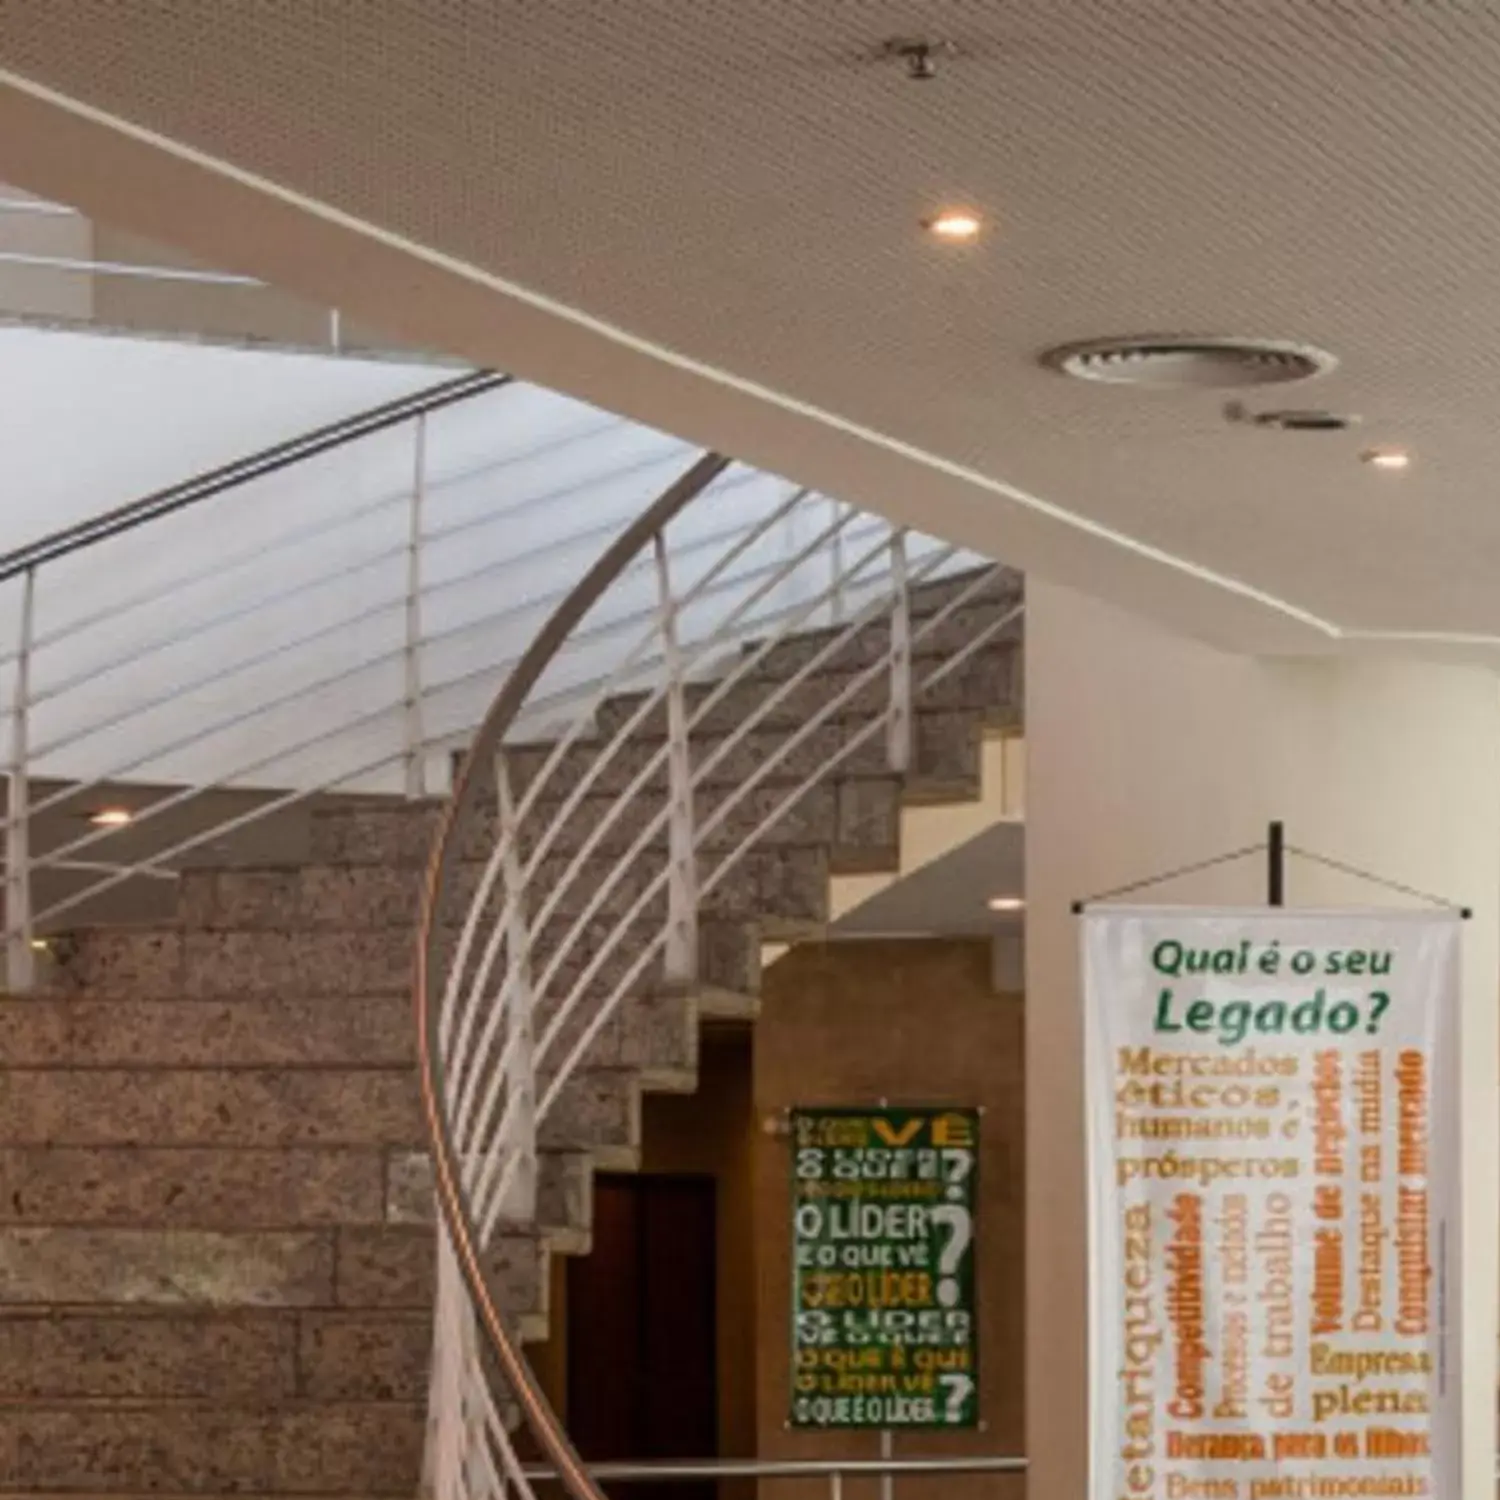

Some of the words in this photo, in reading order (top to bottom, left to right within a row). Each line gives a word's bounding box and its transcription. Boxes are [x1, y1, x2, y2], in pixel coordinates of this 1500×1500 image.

[1151, 940, 1250, 978] Qual
[1258, 941, 1281, 976] é
[1290, 950, 1316, 976] o
[1324, 949, 1394, 976] seu
[1153, 986, 1391, 1046] Legado?
[1116, 1045, 1299, 1078] Mercados
[1115, 1109, 1270, 1140] humanos
[1393, 1048, 1428, 1176] mercado
[1116, 1150, 1299, 1186] prósperos
[1359, 1143, 1382, 1183] na
[796, 1204, 823, 1240] O
[828, 1197, 930, 1240] LÍDER
[1310, 1184, 1344, 1221] de
[1255, 1191, 1294, 1358] trabalho
[1352, 1193, 1388, 1332] Destaque
[1165, 1192, 1212, 1420] Competitividade
[1258, 1372, 1294, 1418] de
[1311, 1384, 1430, 1422] plena
